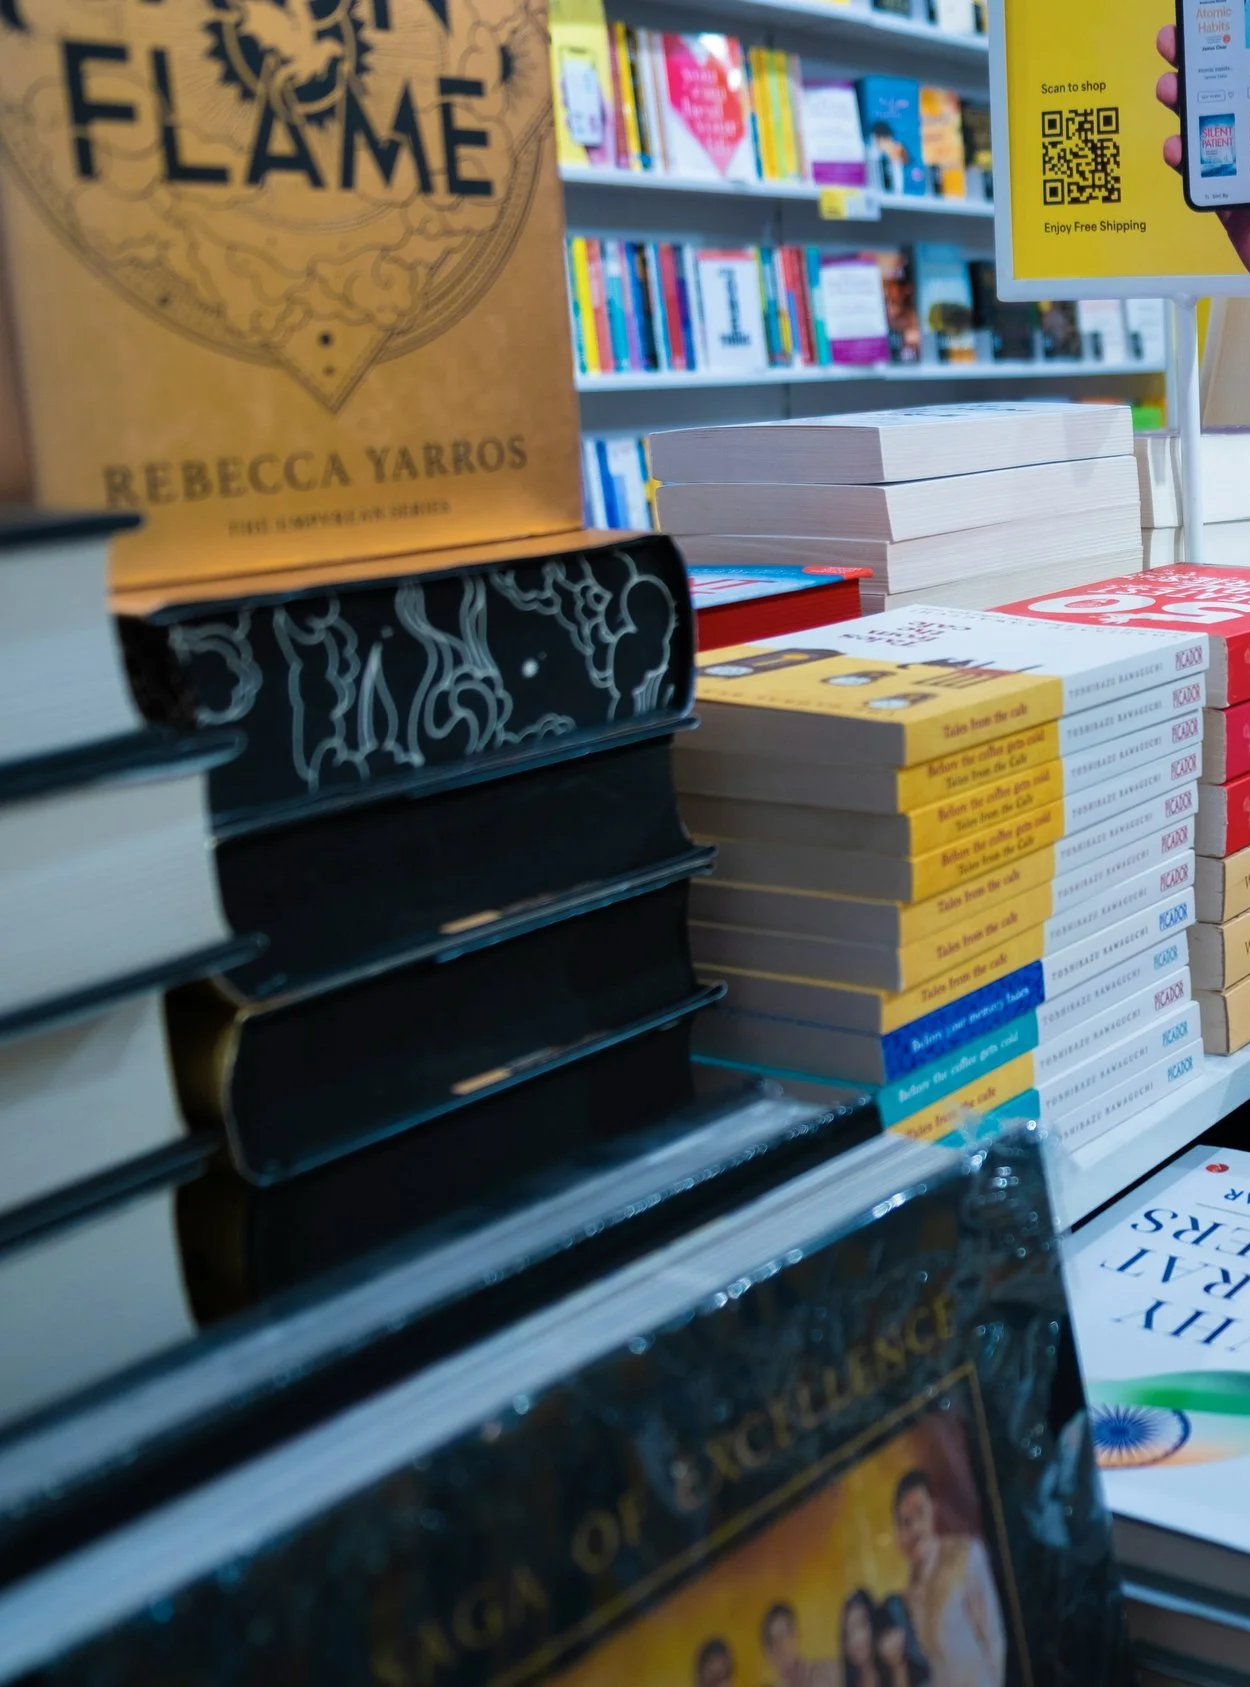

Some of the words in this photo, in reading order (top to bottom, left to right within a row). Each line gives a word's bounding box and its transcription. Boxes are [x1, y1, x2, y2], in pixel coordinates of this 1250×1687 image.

[1041, 83, 1066, 95] Scan
[1068, 82, 1079, 93] to
[1081, 80, 1107, 93] shop
[60, 38, 494, 197] FLAME
[1202, 127, 1232, 137] SILENT
[1202, 137, 1233, 148] PATIENT
[1044, 222, 1072, 235] Enjoy
[1074, 221, 1097, 233] Free
[1100, 219, 1147, 233] Shipping
[104, 450, 352, 508] REBECCA
[366, 436, 529, 483] YARROS
[1175, 646, 1203, 671] PICADOR
[943, 723, 968, 740] Tales
[970, 715, 992, 731] from
[994, 709, 1008, 724] the
[1172, 718, 1198, 743] PICADOR
[1171, 753, 1197, 780] PICADOR
[1165, 791, 1192, 817] PICADOR
[1160, 864, 1188, 892] PICADOR
[1159, 904, 1187, 931] PICADOR
[1154, 981, 1184, 1011] PICADOR
[899, 1081, 930, 1103] Before
[933, 1069, 948, 1083] the
[951, 1055, 977, 1075] coffee
[979, 1044, 999, 1062] gets
[1000, 1031, 1019, 1048] cold
[1167, 1056, 1193, 1083] PICADOR
